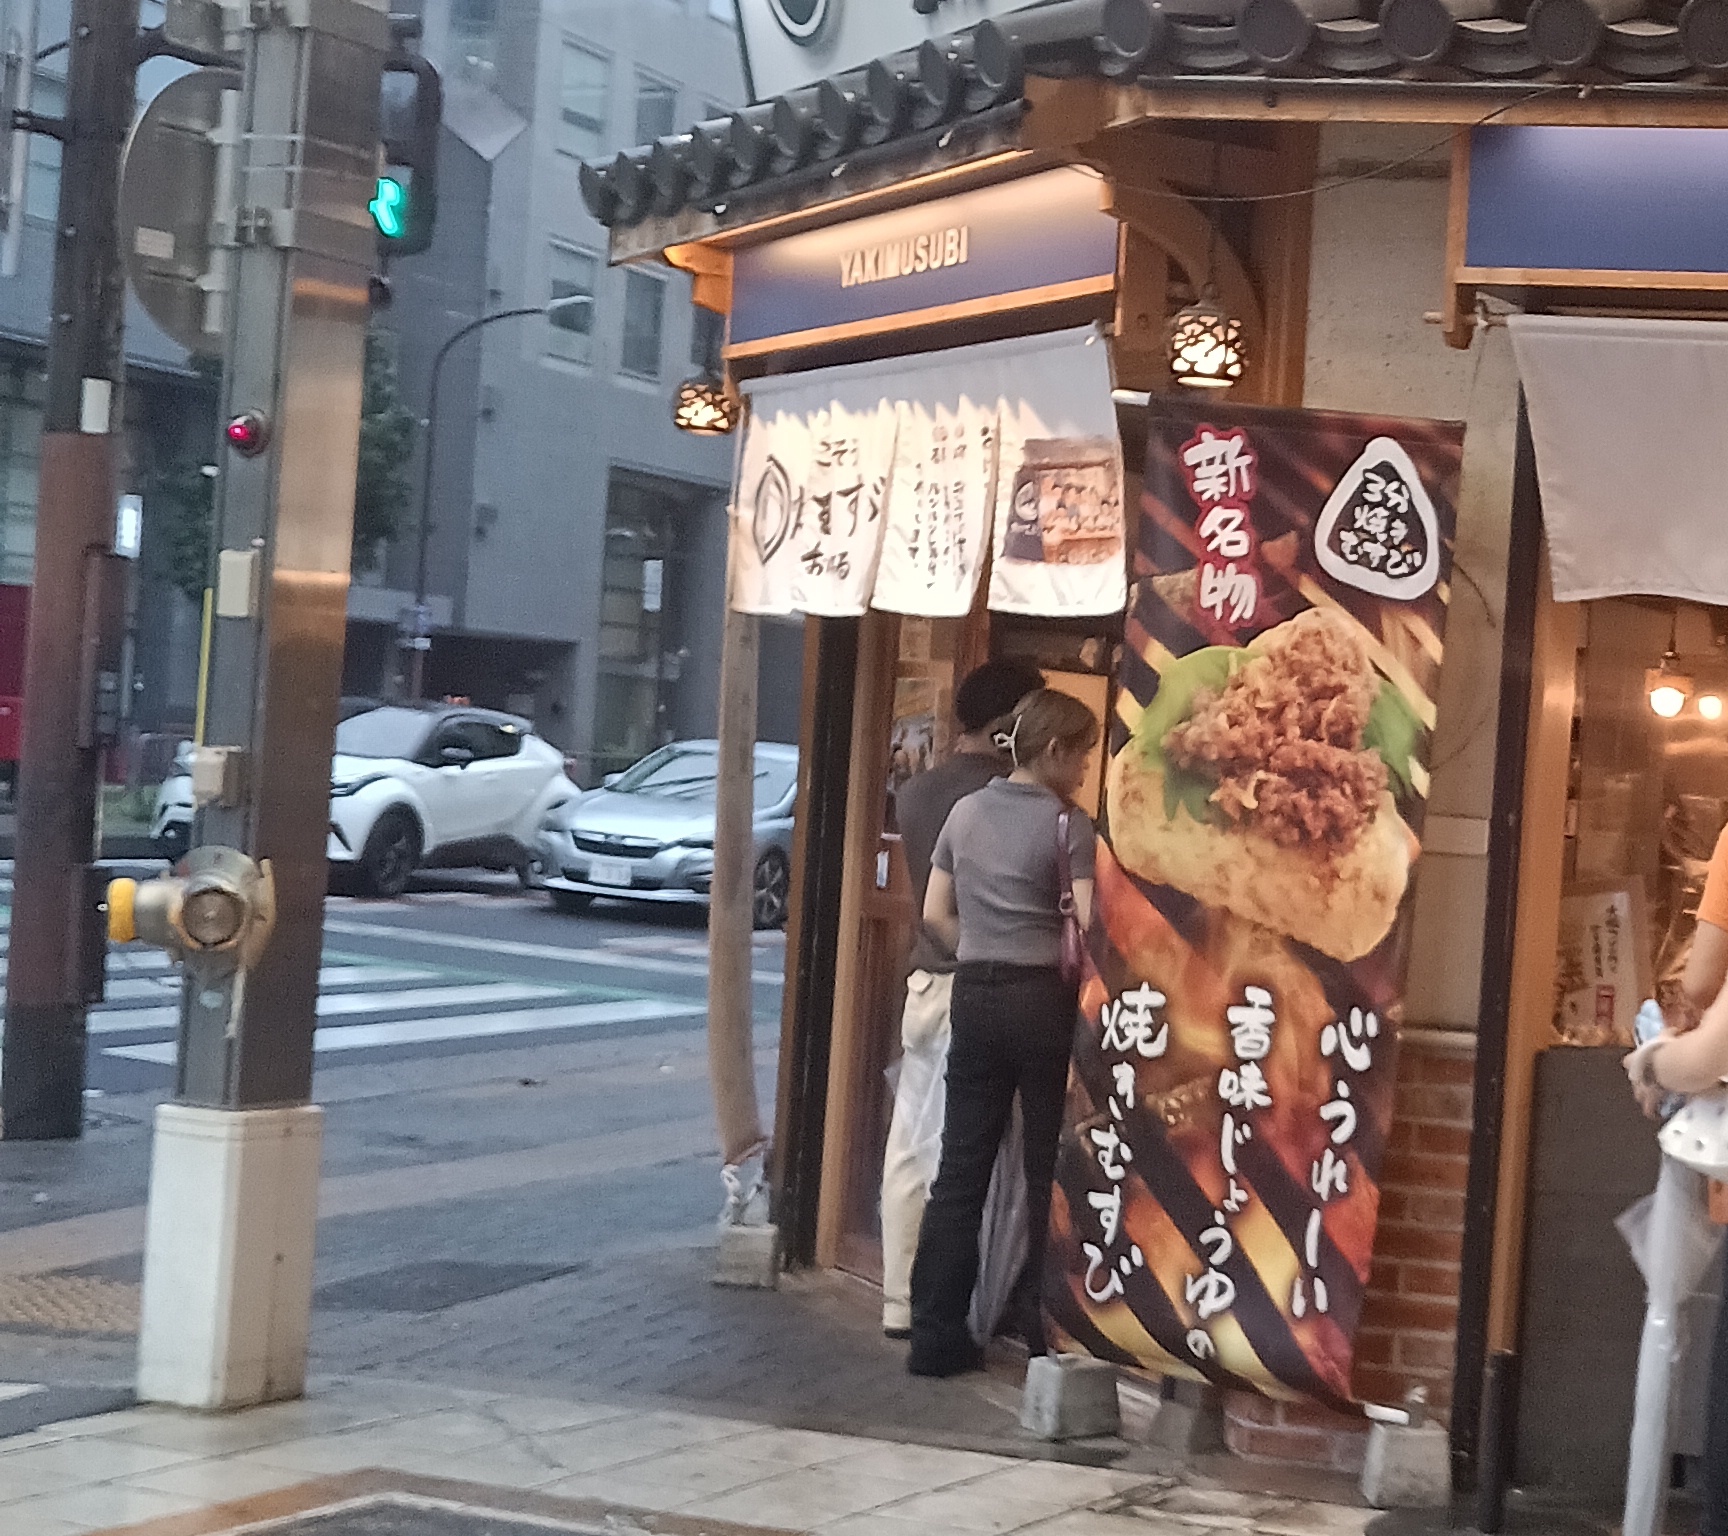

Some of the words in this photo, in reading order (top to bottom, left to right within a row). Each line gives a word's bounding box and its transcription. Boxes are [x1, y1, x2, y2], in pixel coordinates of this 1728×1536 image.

[839, 225, 970, 288] YAKIMUSUBI
[1182, 430, 1257, 625] 新名物
[1339, 530, 1423, 576] むすび
[1361, 471, 1409, 514] 3分
[1083, 981, 1169, 1303] 焼きむすび
[1185, 985, 1276, 1360] 香味じょうゆの
